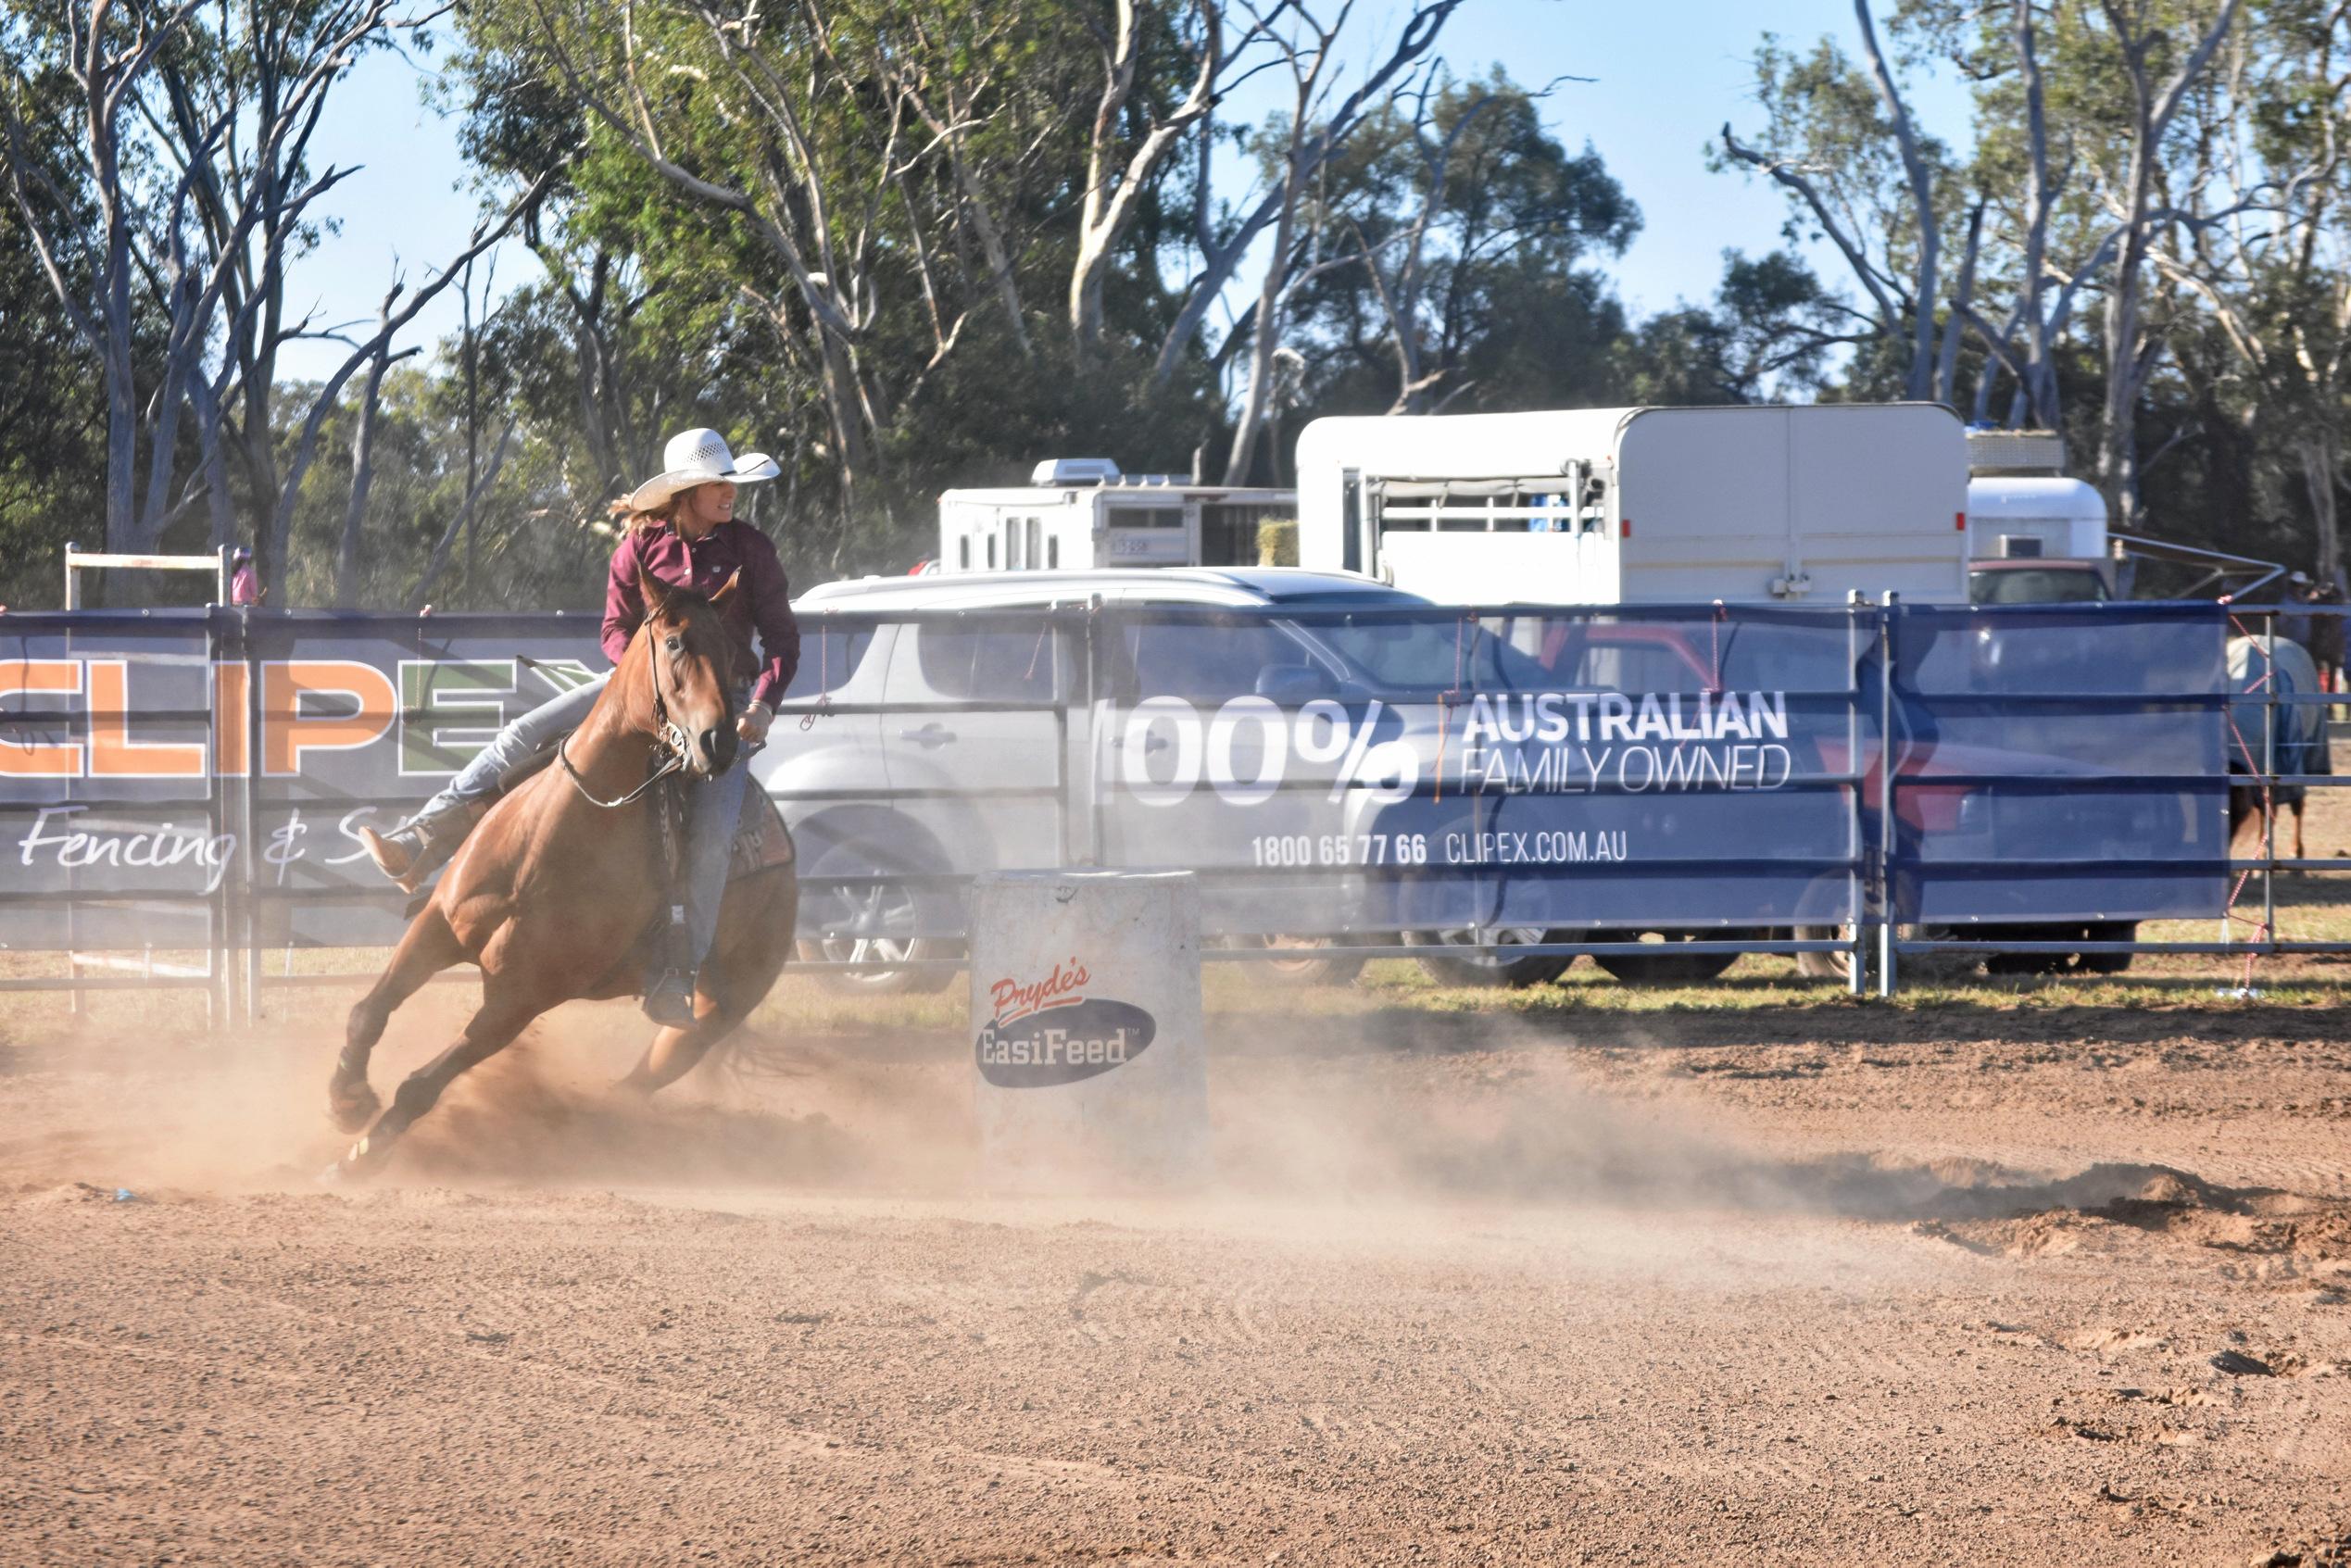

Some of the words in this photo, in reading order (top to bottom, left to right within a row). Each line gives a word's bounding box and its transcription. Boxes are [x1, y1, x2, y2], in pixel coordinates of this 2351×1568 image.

[0, 659, 606, 777] CLIPE
[1461, 691, 1790, 743] AUSTRALIAN
[1459, 746, 1612, 796] FAMILY
[1617, 743, 1792, 794] OWNED
[18, 804, 238, 897] Fencing
[263, 807, 308, 886] &
[1251, 834, 1313, 867] 1800
[1317, 834, 1351, 867] 65
[1356, 833, 1389, 867] 77
[1394, 832, 1427, 865] 66
[1444, 830, 1628, 865] CLIPEX.COM.AU
[982, 1027, 1127, 1066] EasiFeed
